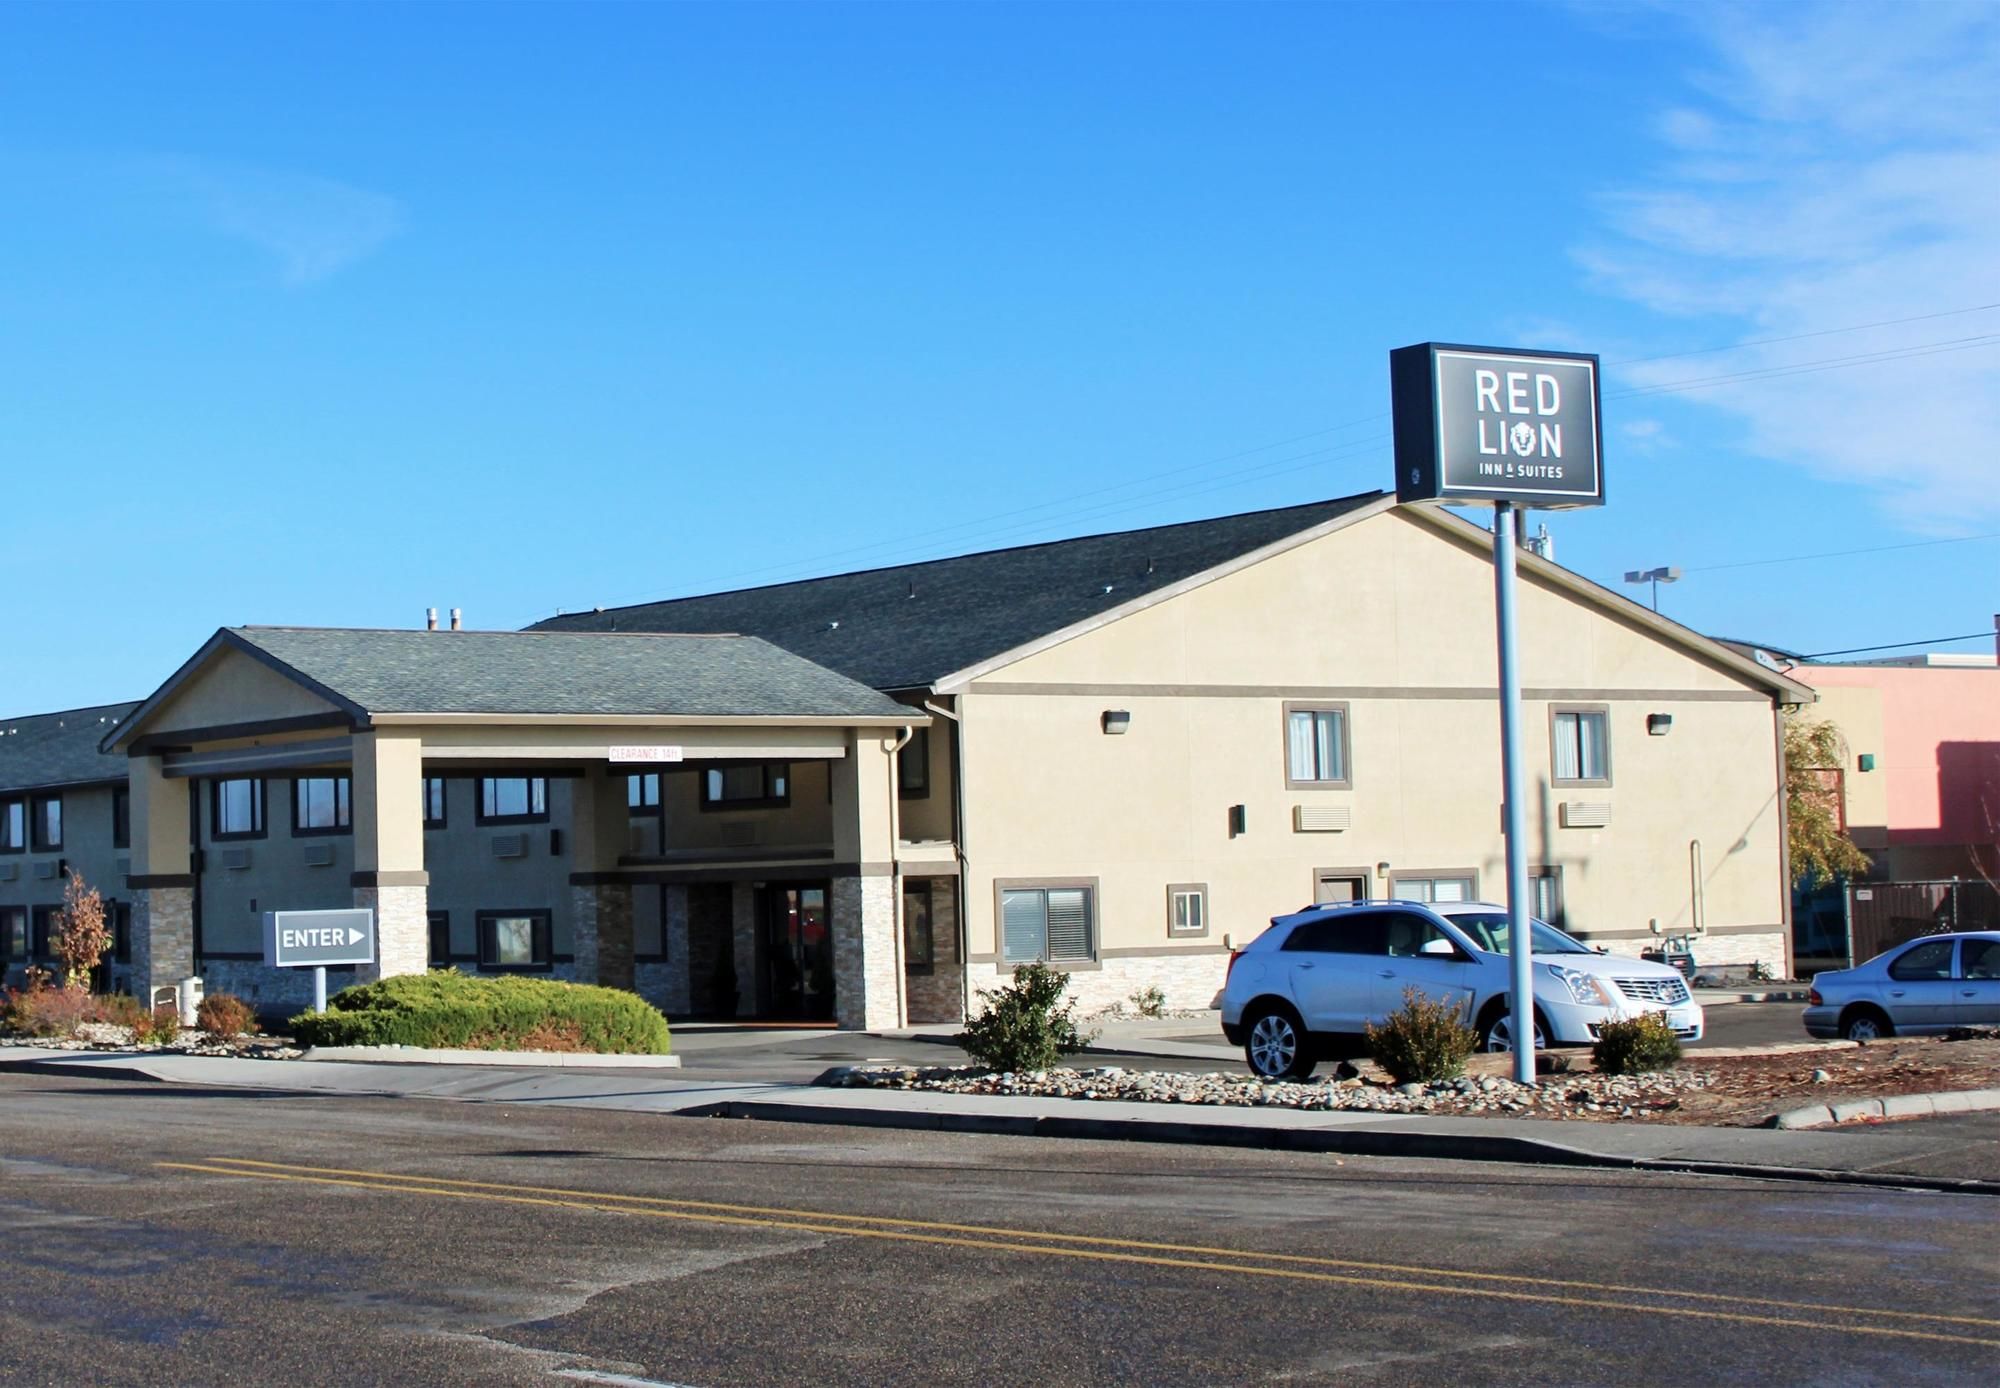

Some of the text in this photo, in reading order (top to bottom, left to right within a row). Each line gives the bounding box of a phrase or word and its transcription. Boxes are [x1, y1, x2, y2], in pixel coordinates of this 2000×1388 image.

[1475, 369, 1560, 416] RED
[1478, 419, 1562, 458] LION
[1479, 462, 1563, 478] INN & SUITES
[611, 748, 658, 760] CLEARANCE
[282, 928, 345, 948] ENTER
